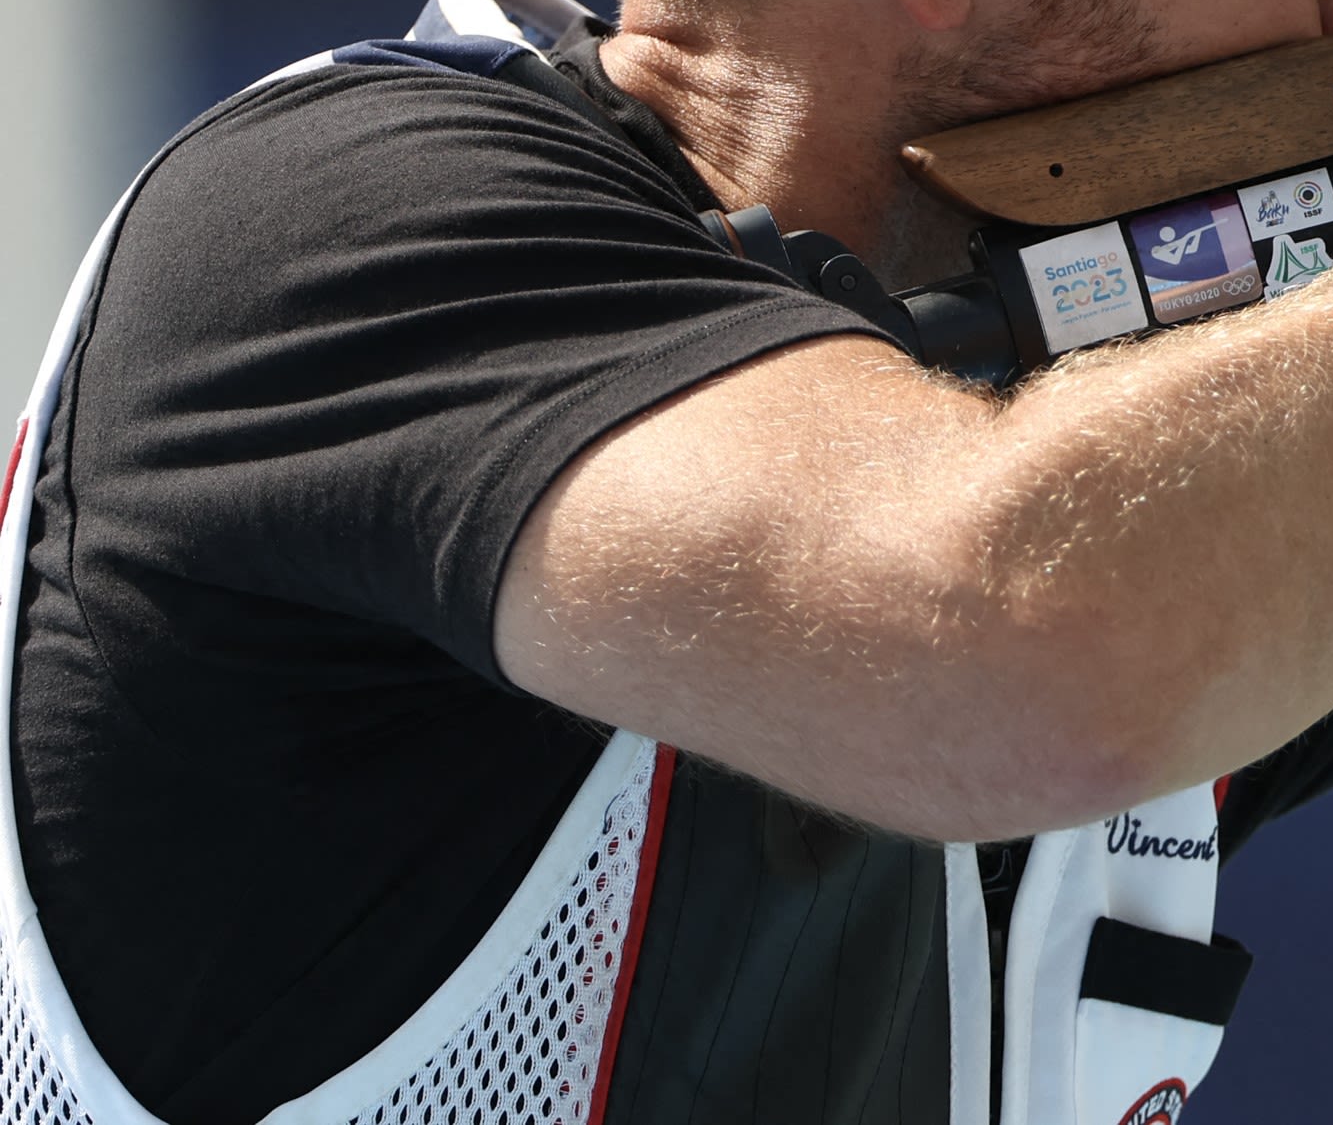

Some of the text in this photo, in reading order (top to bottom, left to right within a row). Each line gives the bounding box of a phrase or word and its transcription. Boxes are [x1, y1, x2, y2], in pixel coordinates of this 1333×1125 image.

[1303, 207, 1323, 219] ISSF
[1044, 251, 1118, 281] Santiago
[1052, 268, 1128, 313] 2023
[1158, 287, 1221, 313] TOKYO 2020
[1104, 812, 1218, 861] Vincent
